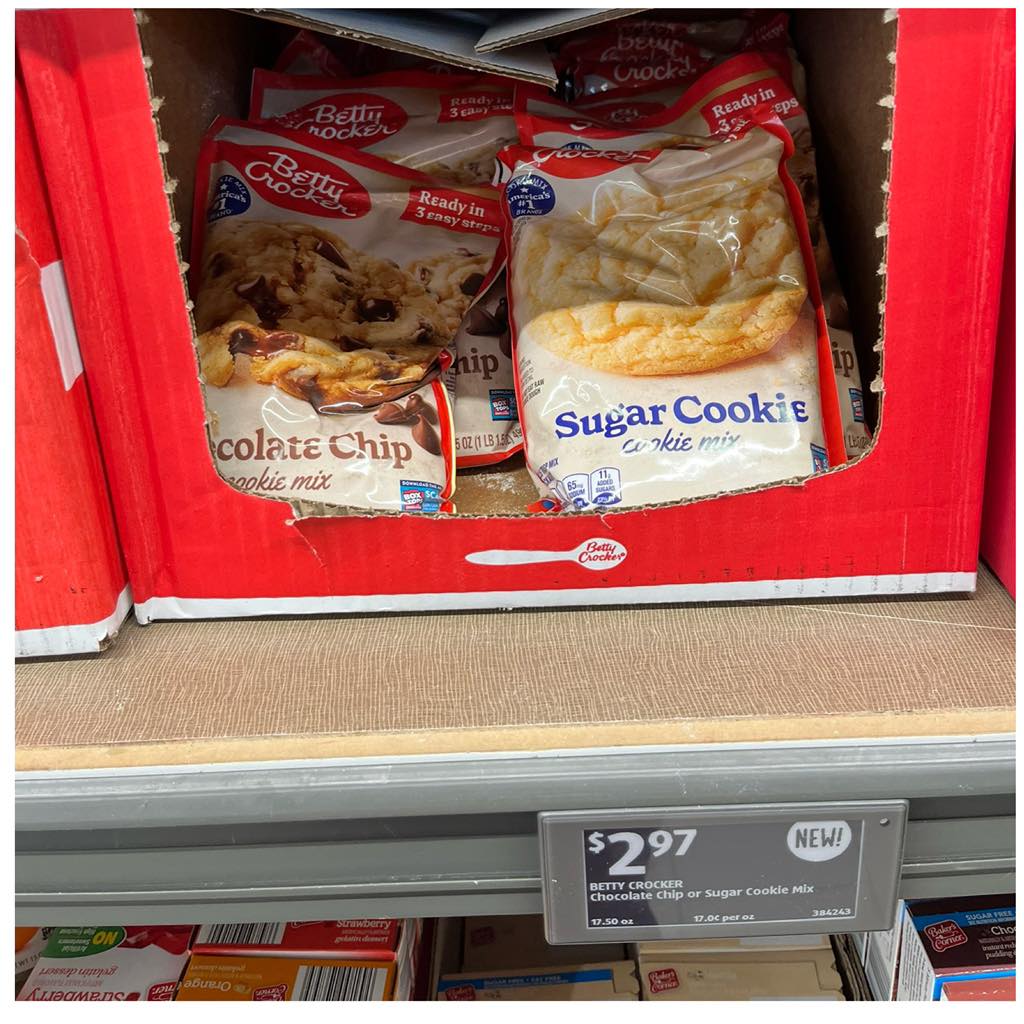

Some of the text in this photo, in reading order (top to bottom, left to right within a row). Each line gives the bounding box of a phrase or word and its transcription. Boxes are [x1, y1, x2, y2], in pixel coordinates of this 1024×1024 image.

[711, 88, 776, 118] Ready in
[770, 96, 799, 116] eps
[308, 103, 386, 126] Betty
[267, 151, 350, 204] Betty
[244, 161, 357, 217] Crocker
[418, 190, 486, 218] Ready in
[415, 206, 426, 218] 3
[426, 209, 461, 227] easy
[453, 347, 500, 381] hip
[831, 340, 855, 378] ip
[554, 392, 810, 440] Sugar Cookie
[211, 428, 412, 470] colate Chip
[461, 437, 474, 449] OZ
[484, 435, 495, 448] LB
[621, 428, 742, 456] cookie mix
[289, 470, 334, 490] mix
[403, 491, 423, 501] BOX
[578, 550, 623, 564] Crocker
[586, 541, 617, 555] Betty
[795, 827, 843, 850] NEW!
[590, 879, 684, 892] BETTY CROCKER
[590, 884, 815, 903] Chocolate Chip or Sugar Cookie Mix
[591, 918, 635, 926] 17.50 oz
[722, 913, 755, 924] per oz
[812, 908, 852, 918] 384243
[965, 910, 1014, 921] SUGAR FREE
[336, 919, 392, 931] Strawberry
[92, 931, 119, 946] NO
[183, 978, 232, 993] Orange
